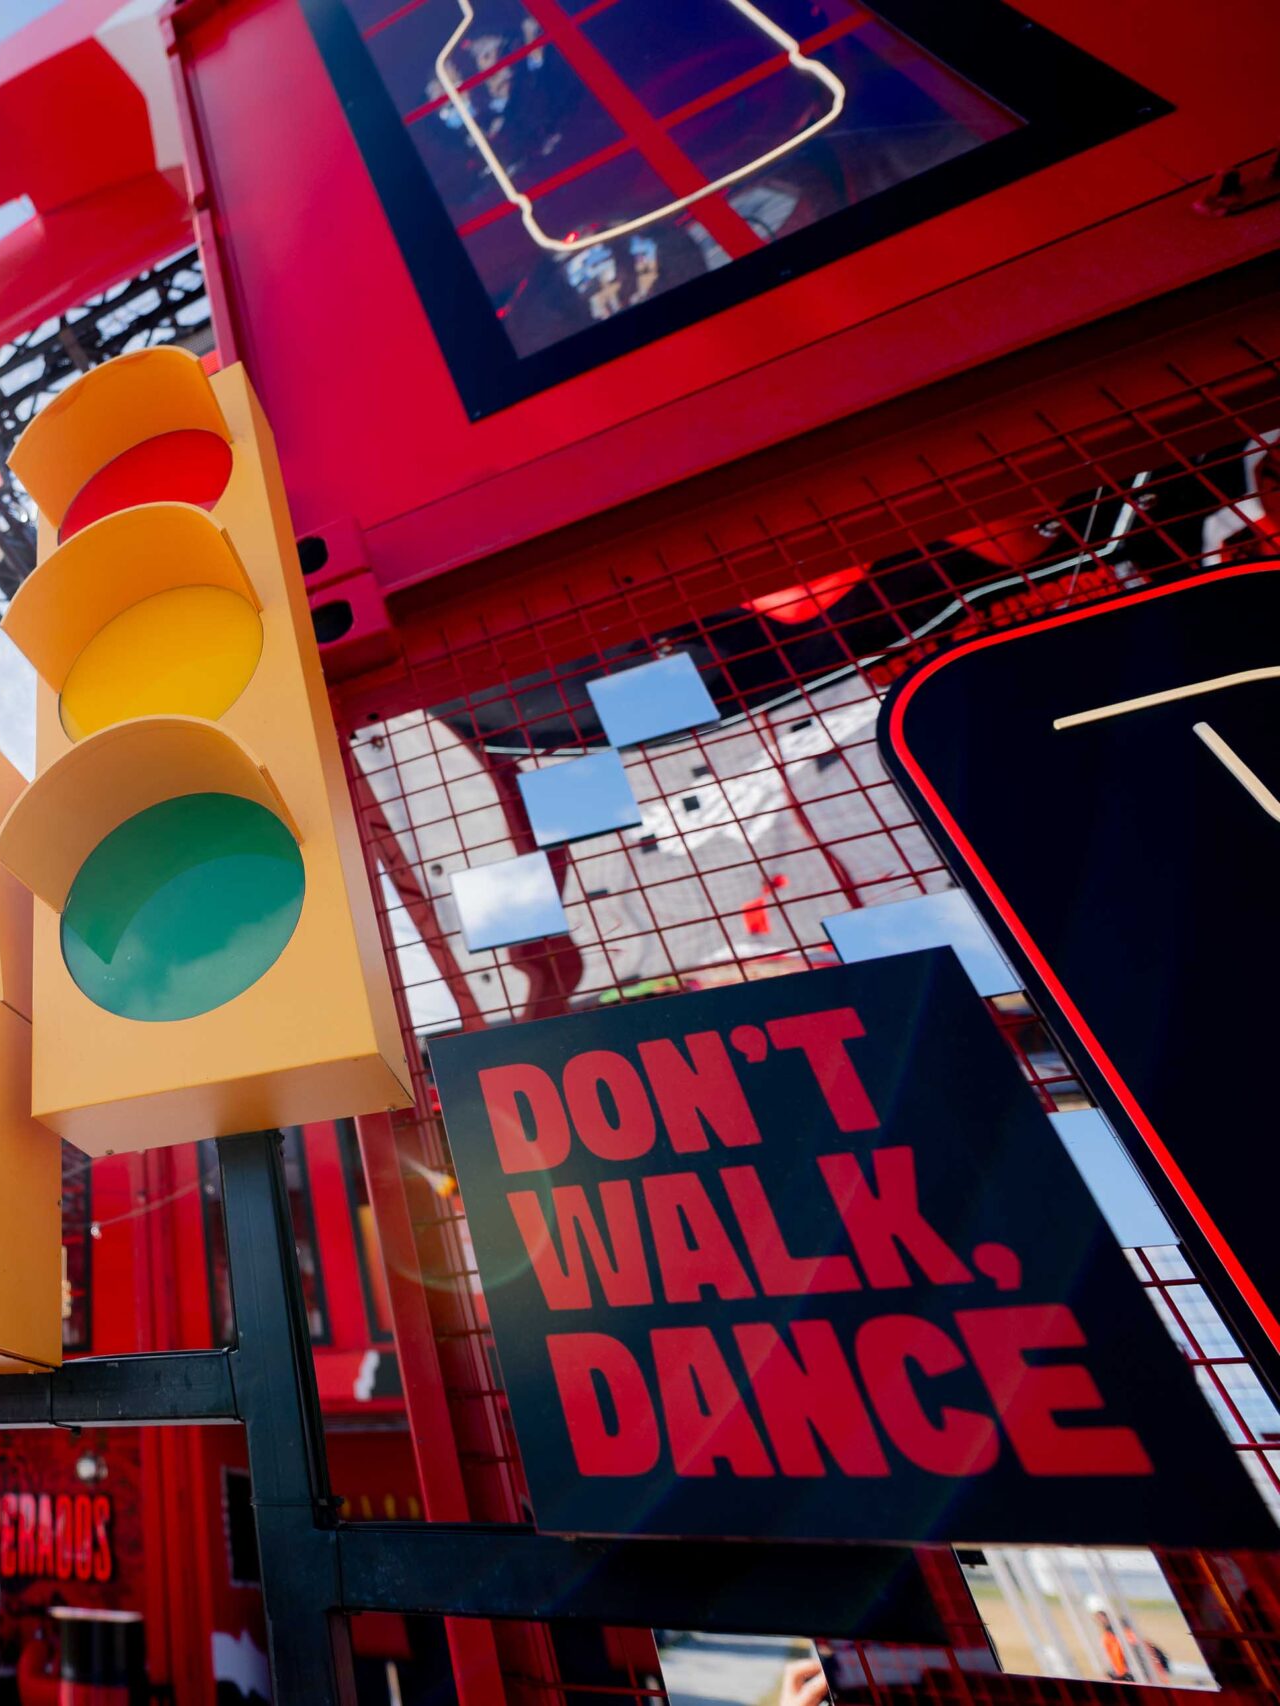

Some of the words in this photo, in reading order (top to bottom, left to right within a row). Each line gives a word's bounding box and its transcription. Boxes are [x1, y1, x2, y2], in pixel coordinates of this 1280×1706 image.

[478, 1006, 881, 1176] DON'T
[507, 1146, 1022, 1311] WALK,
[546, 1304, 1156, 1478] DANCE
